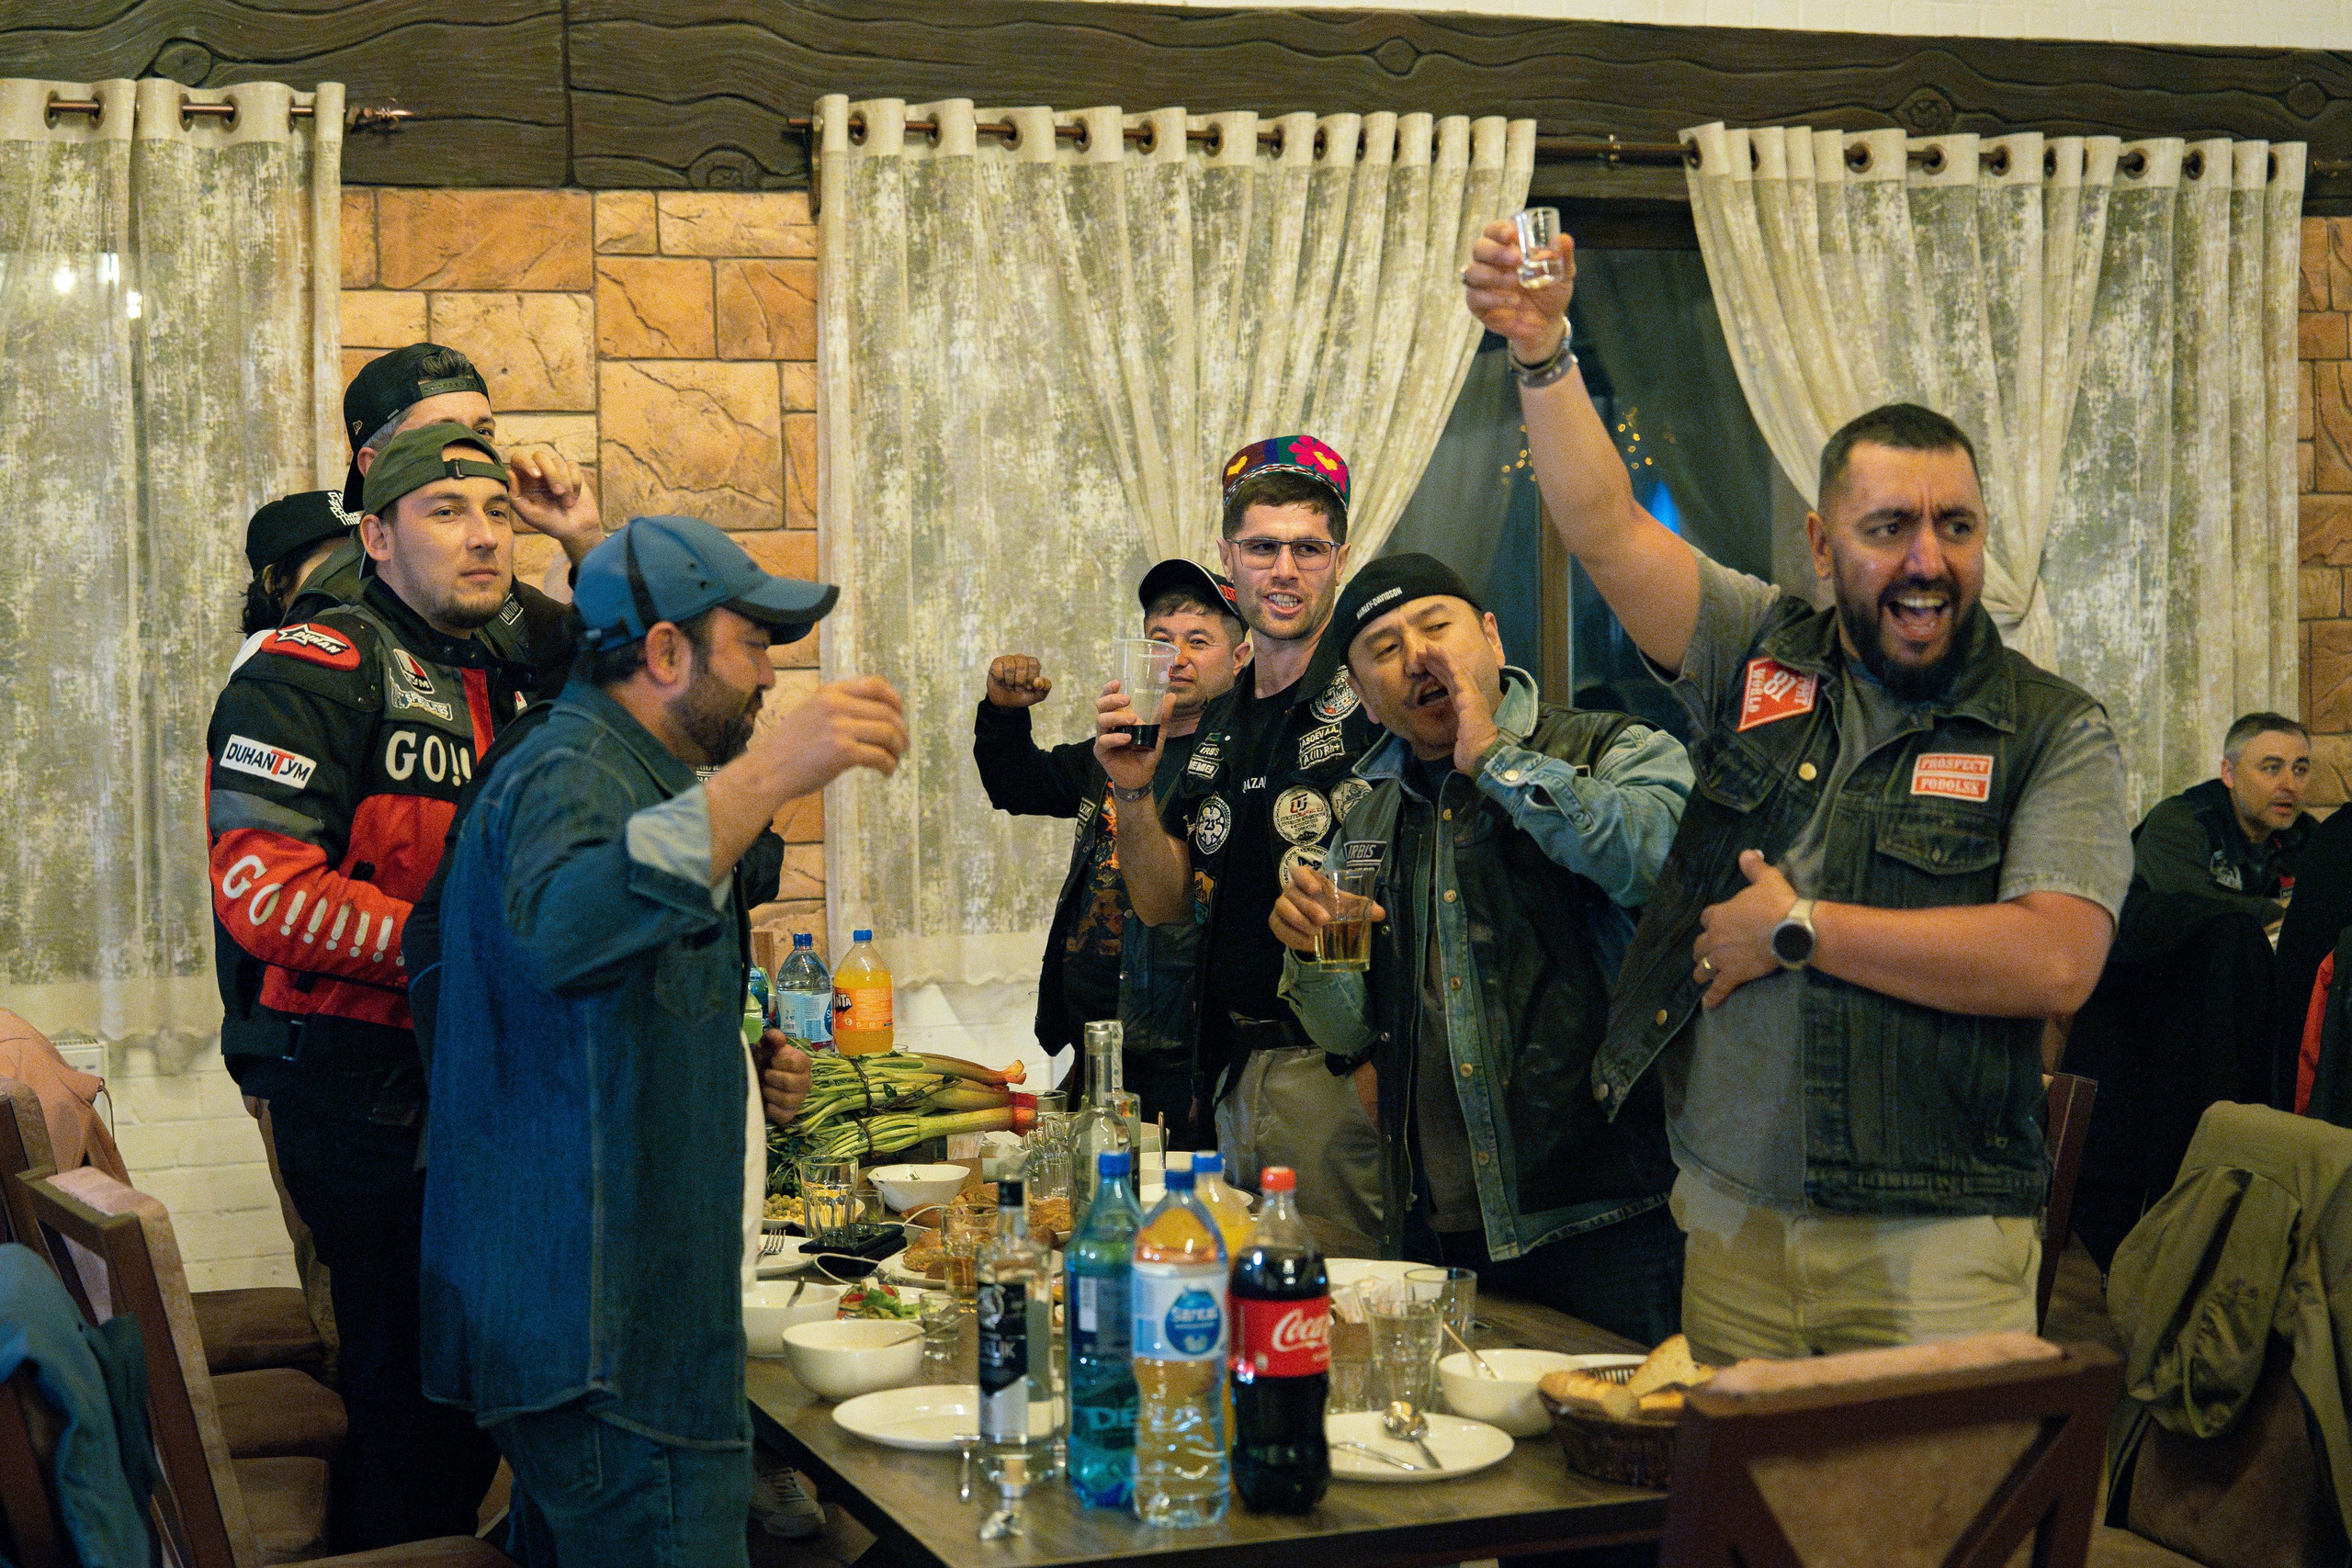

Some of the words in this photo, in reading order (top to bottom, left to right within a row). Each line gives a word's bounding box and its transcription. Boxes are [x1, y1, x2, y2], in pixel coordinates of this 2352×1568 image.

[1356, 586, 1403, 620] HARLEY-DAVIDSON
[1920, 758, 1987, 773] PROSPECT
[1920, 778, 1981, 795] PODOLSK
[1347, 844, 1377, 859] IRBIS
